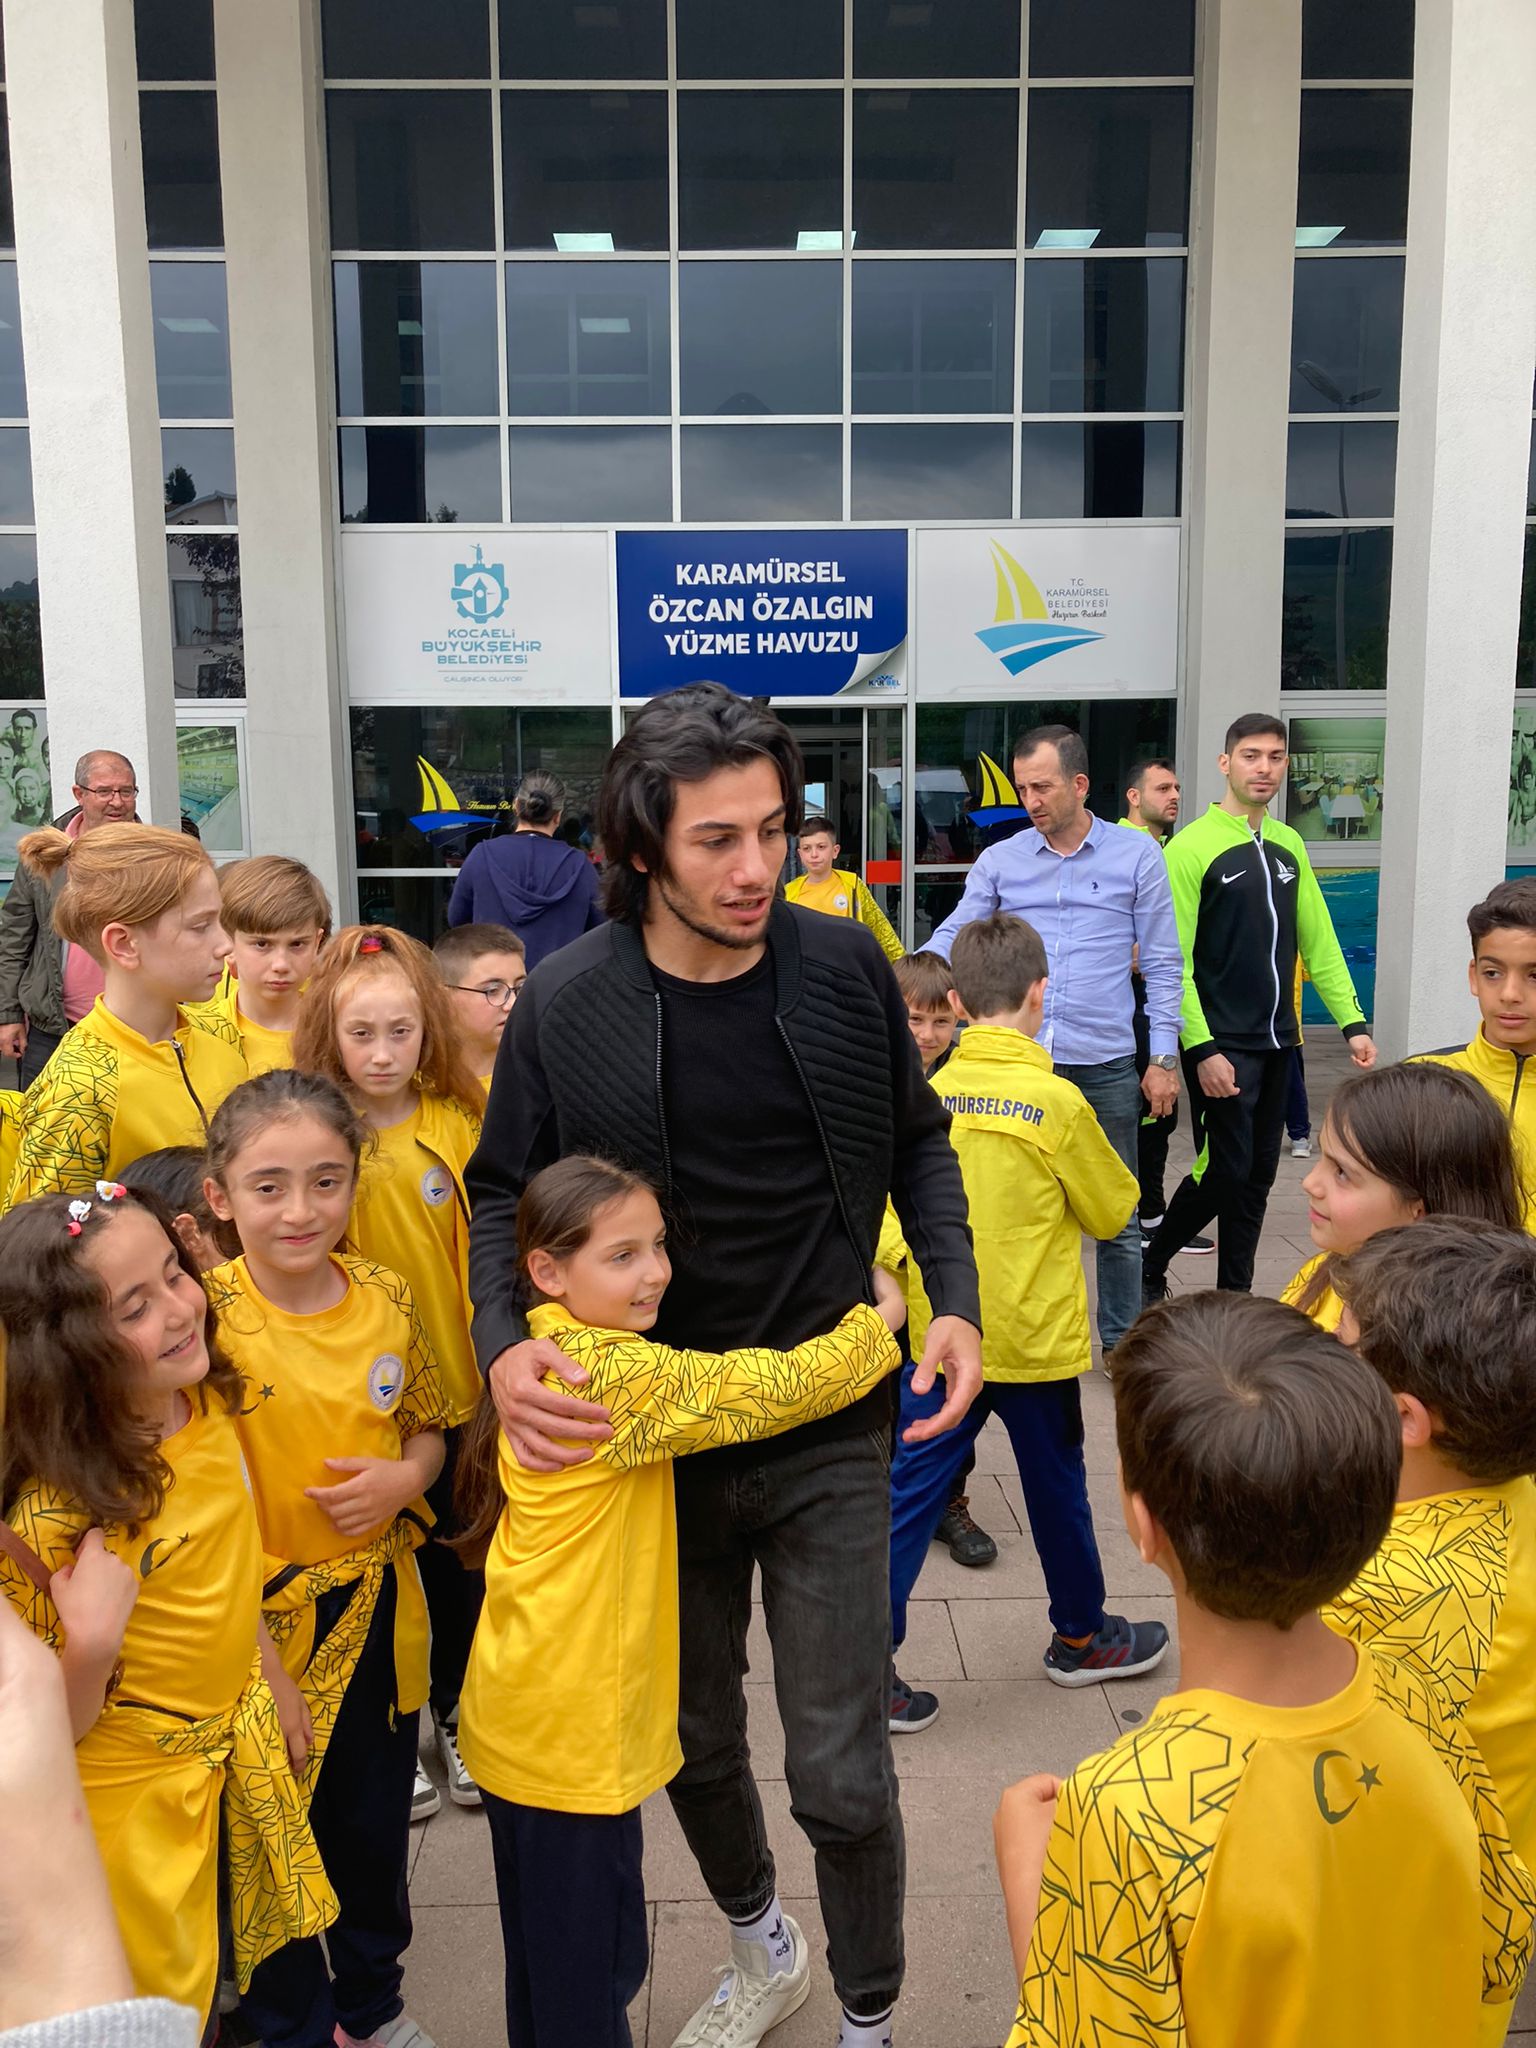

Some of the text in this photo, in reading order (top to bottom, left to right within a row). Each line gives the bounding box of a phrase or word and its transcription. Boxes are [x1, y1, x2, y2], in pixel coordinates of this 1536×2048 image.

[676, 558, 846, 585] KARAMÜRSEL
[1046, 588, 1110, 597] KARAMÜRSEL
[648, 592, 873, 623] ÖZCAN ÖZALGIN
[1048, 599, 1109, 608] BELEDİYESİ
[447, 628, 515, 638] KOCAELİ
[421, 640, 542, 653] BÜYÜKŞEHİR
[664, 630, 859, 655] YÜZME HAVUZU
[437, 654, 528, 664] BELEDİYESİ
[939, 1093, 1045, 1126] MÜRSELSPOR
